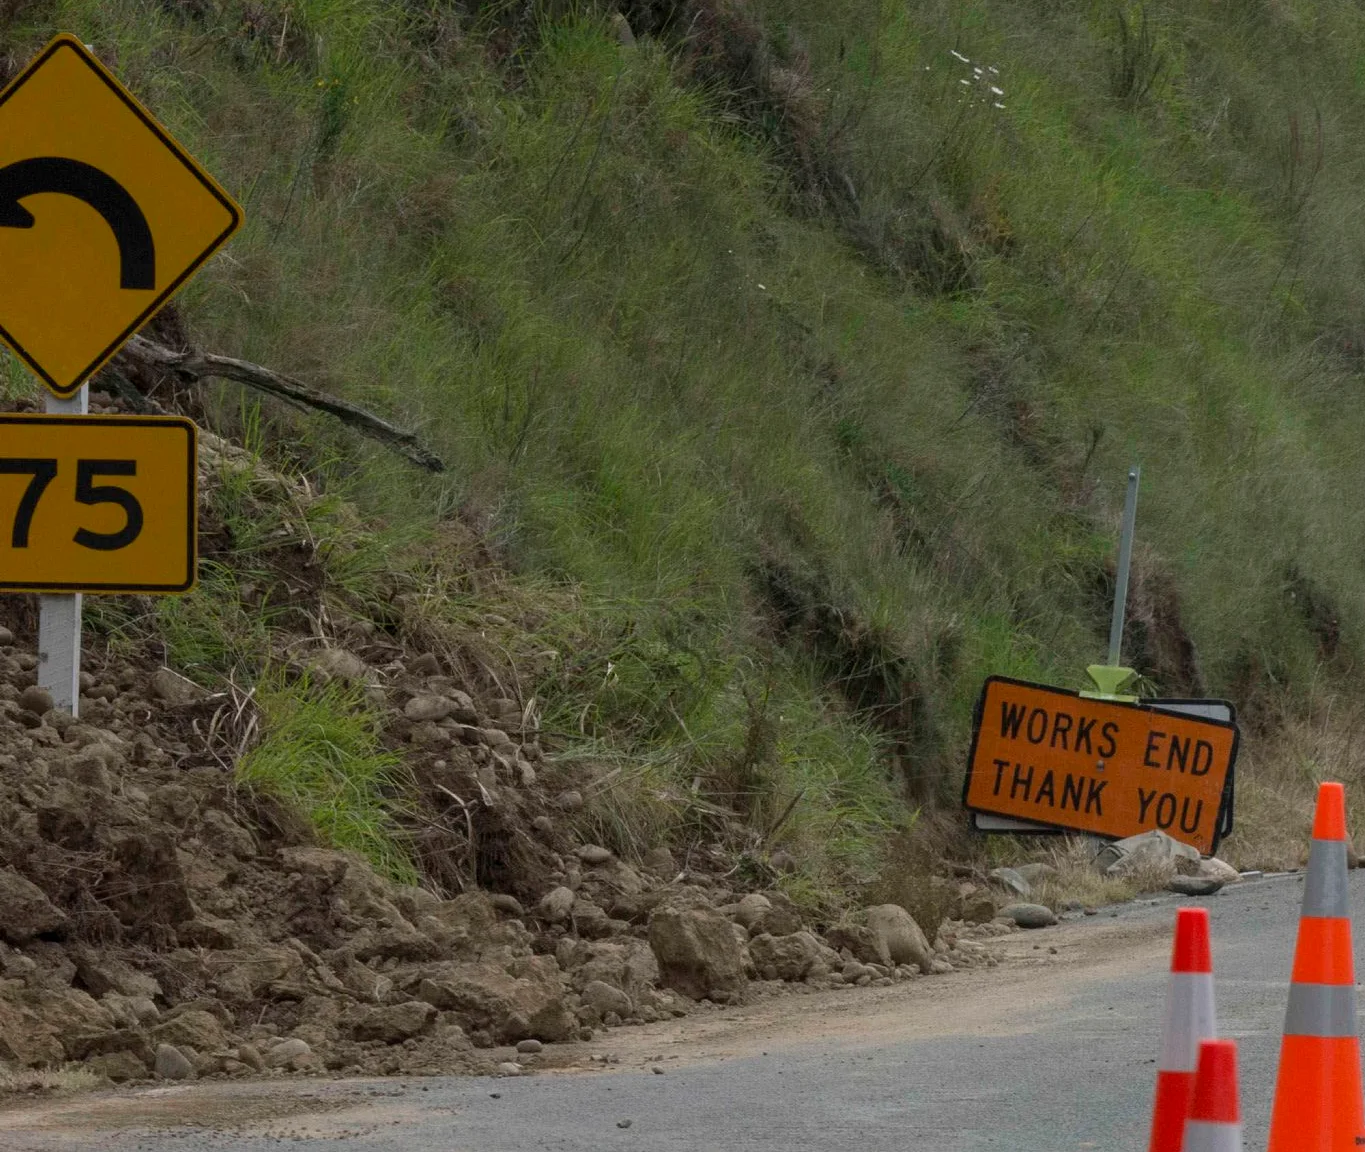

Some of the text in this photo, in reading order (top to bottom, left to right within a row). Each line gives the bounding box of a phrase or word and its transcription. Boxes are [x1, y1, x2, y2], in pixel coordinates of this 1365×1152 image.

[0, 458, 144, 551] 75
[1000, 701, 1214, 776] WORKS END
[992, 758, 1203, 834] THANK YOU
